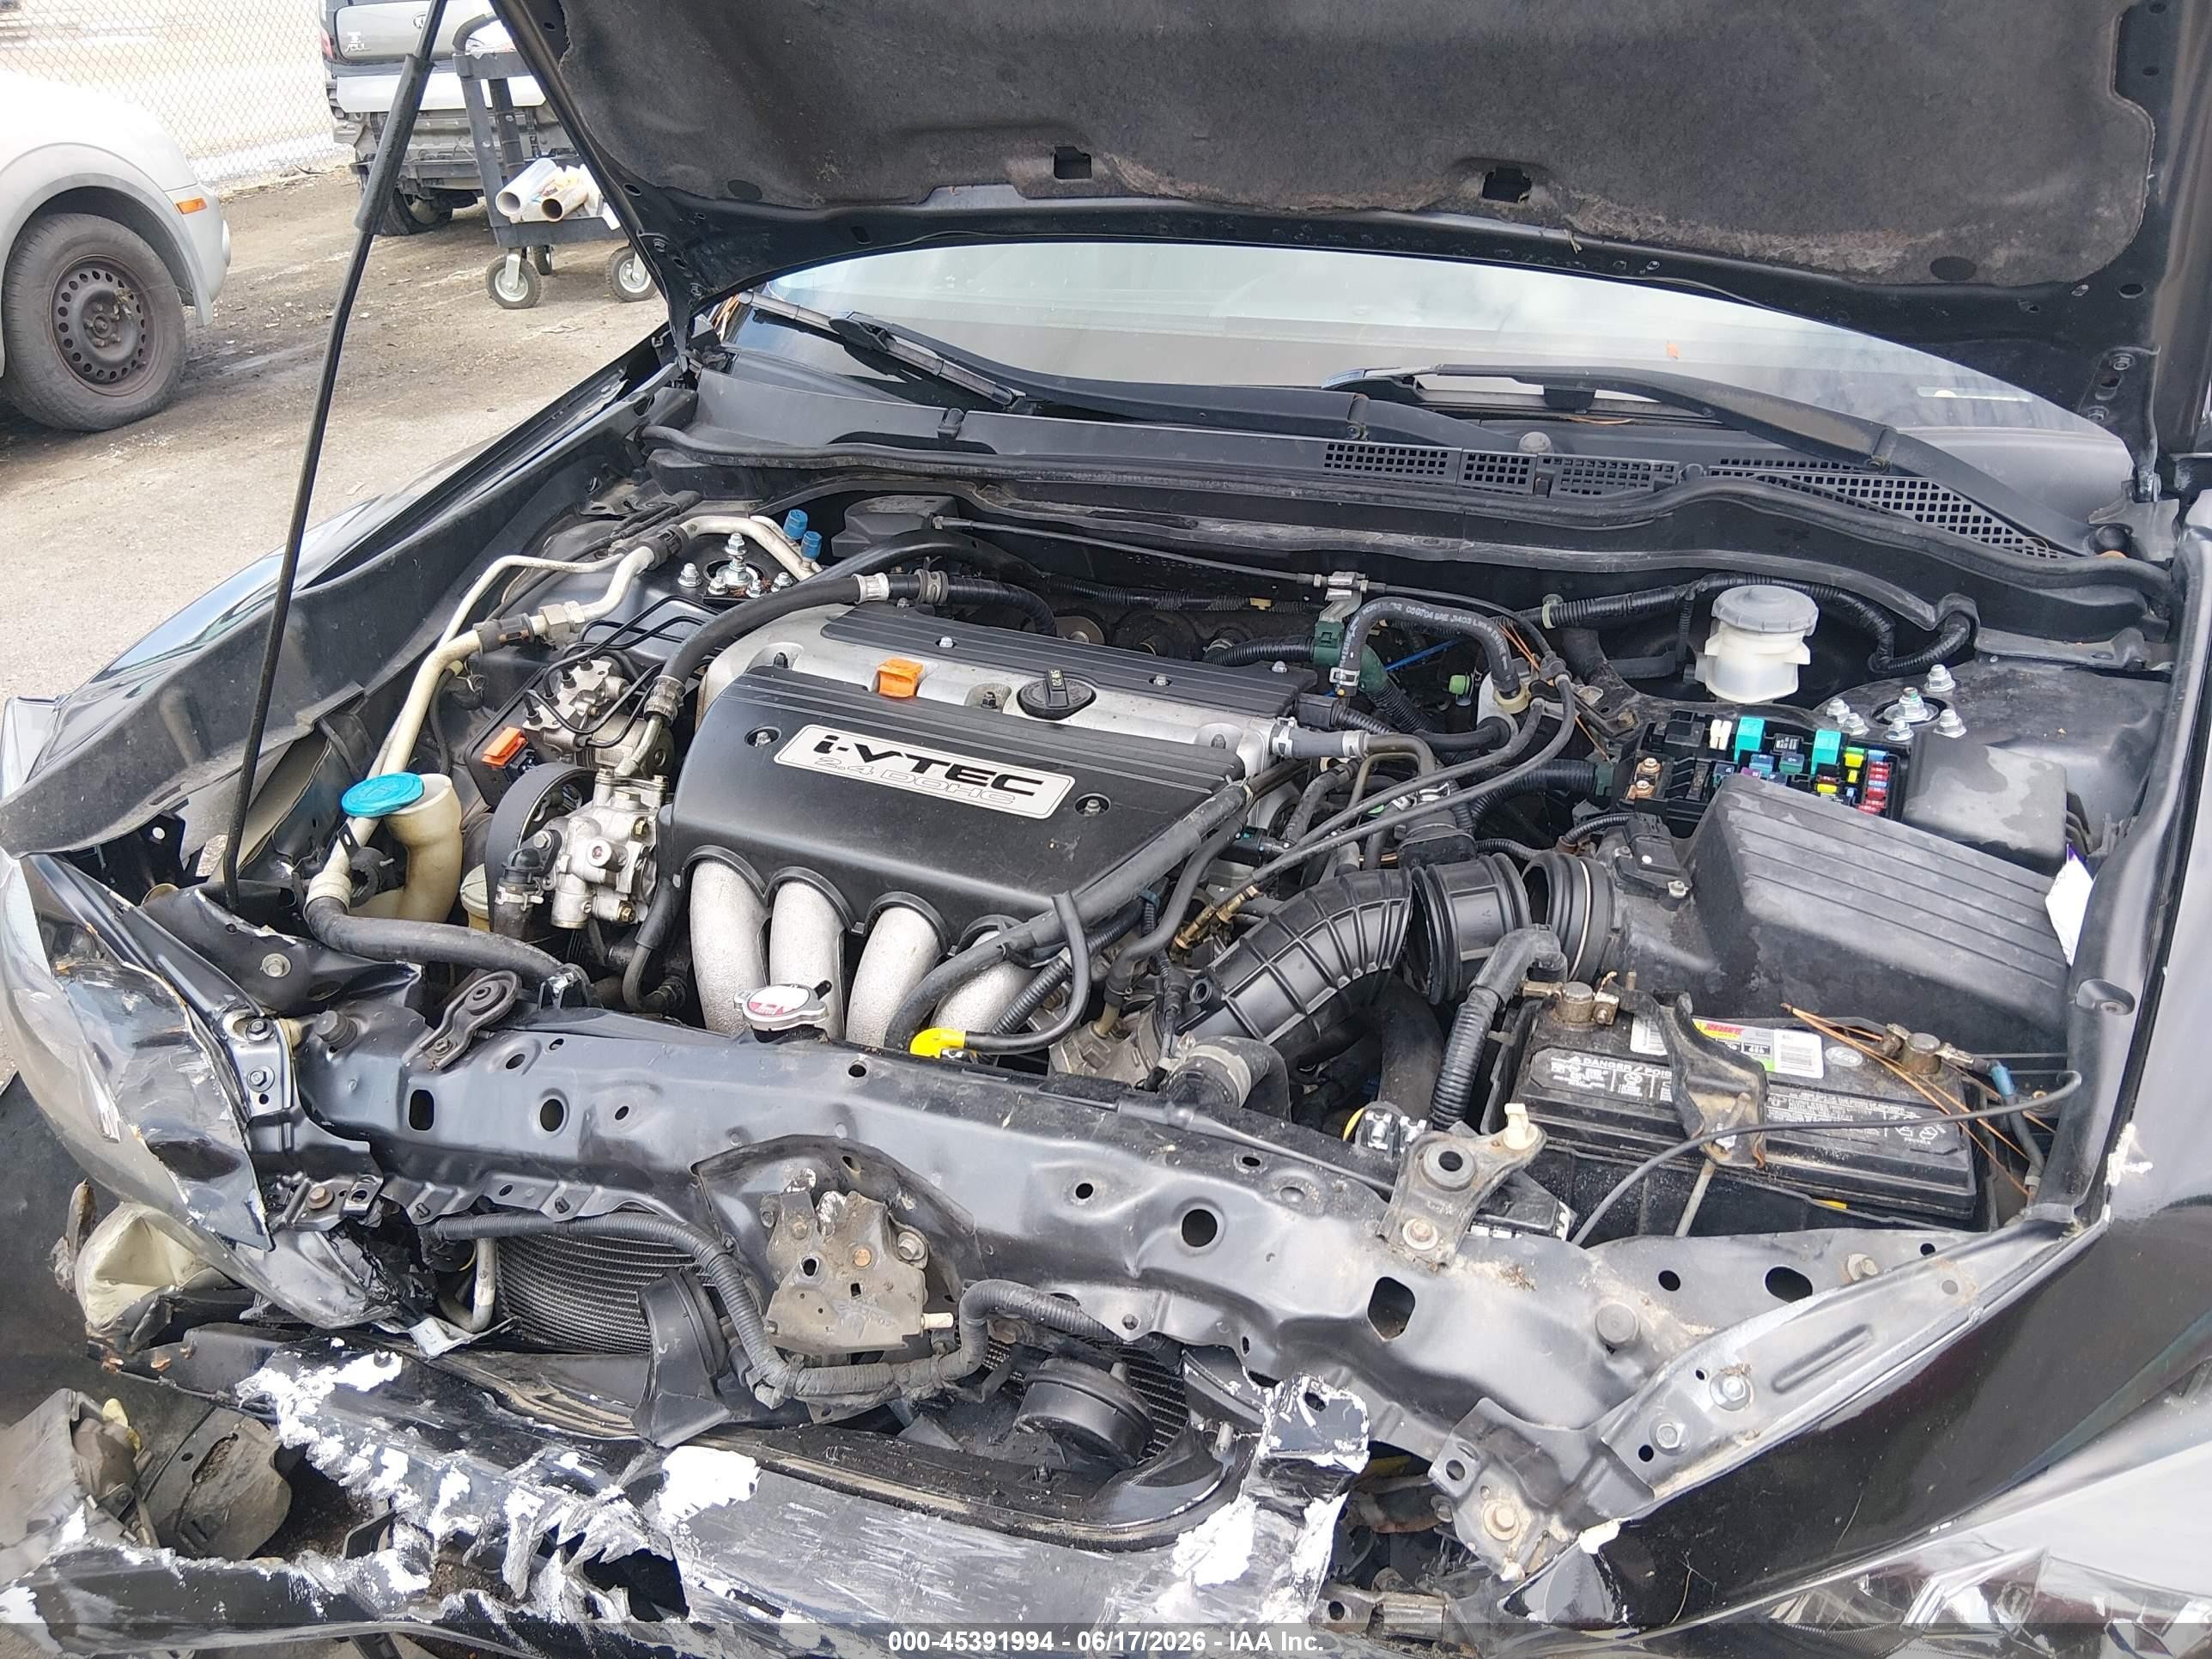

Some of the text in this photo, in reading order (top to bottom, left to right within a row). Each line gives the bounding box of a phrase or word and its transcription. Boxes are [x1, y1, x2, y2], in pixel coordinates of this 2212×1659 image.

[814, 735, 1044, 796] i-VTEC
[814, 757, 1016, 805] 2.4 DOHC
[1583, 1057, 1632, 1073] DANGER
